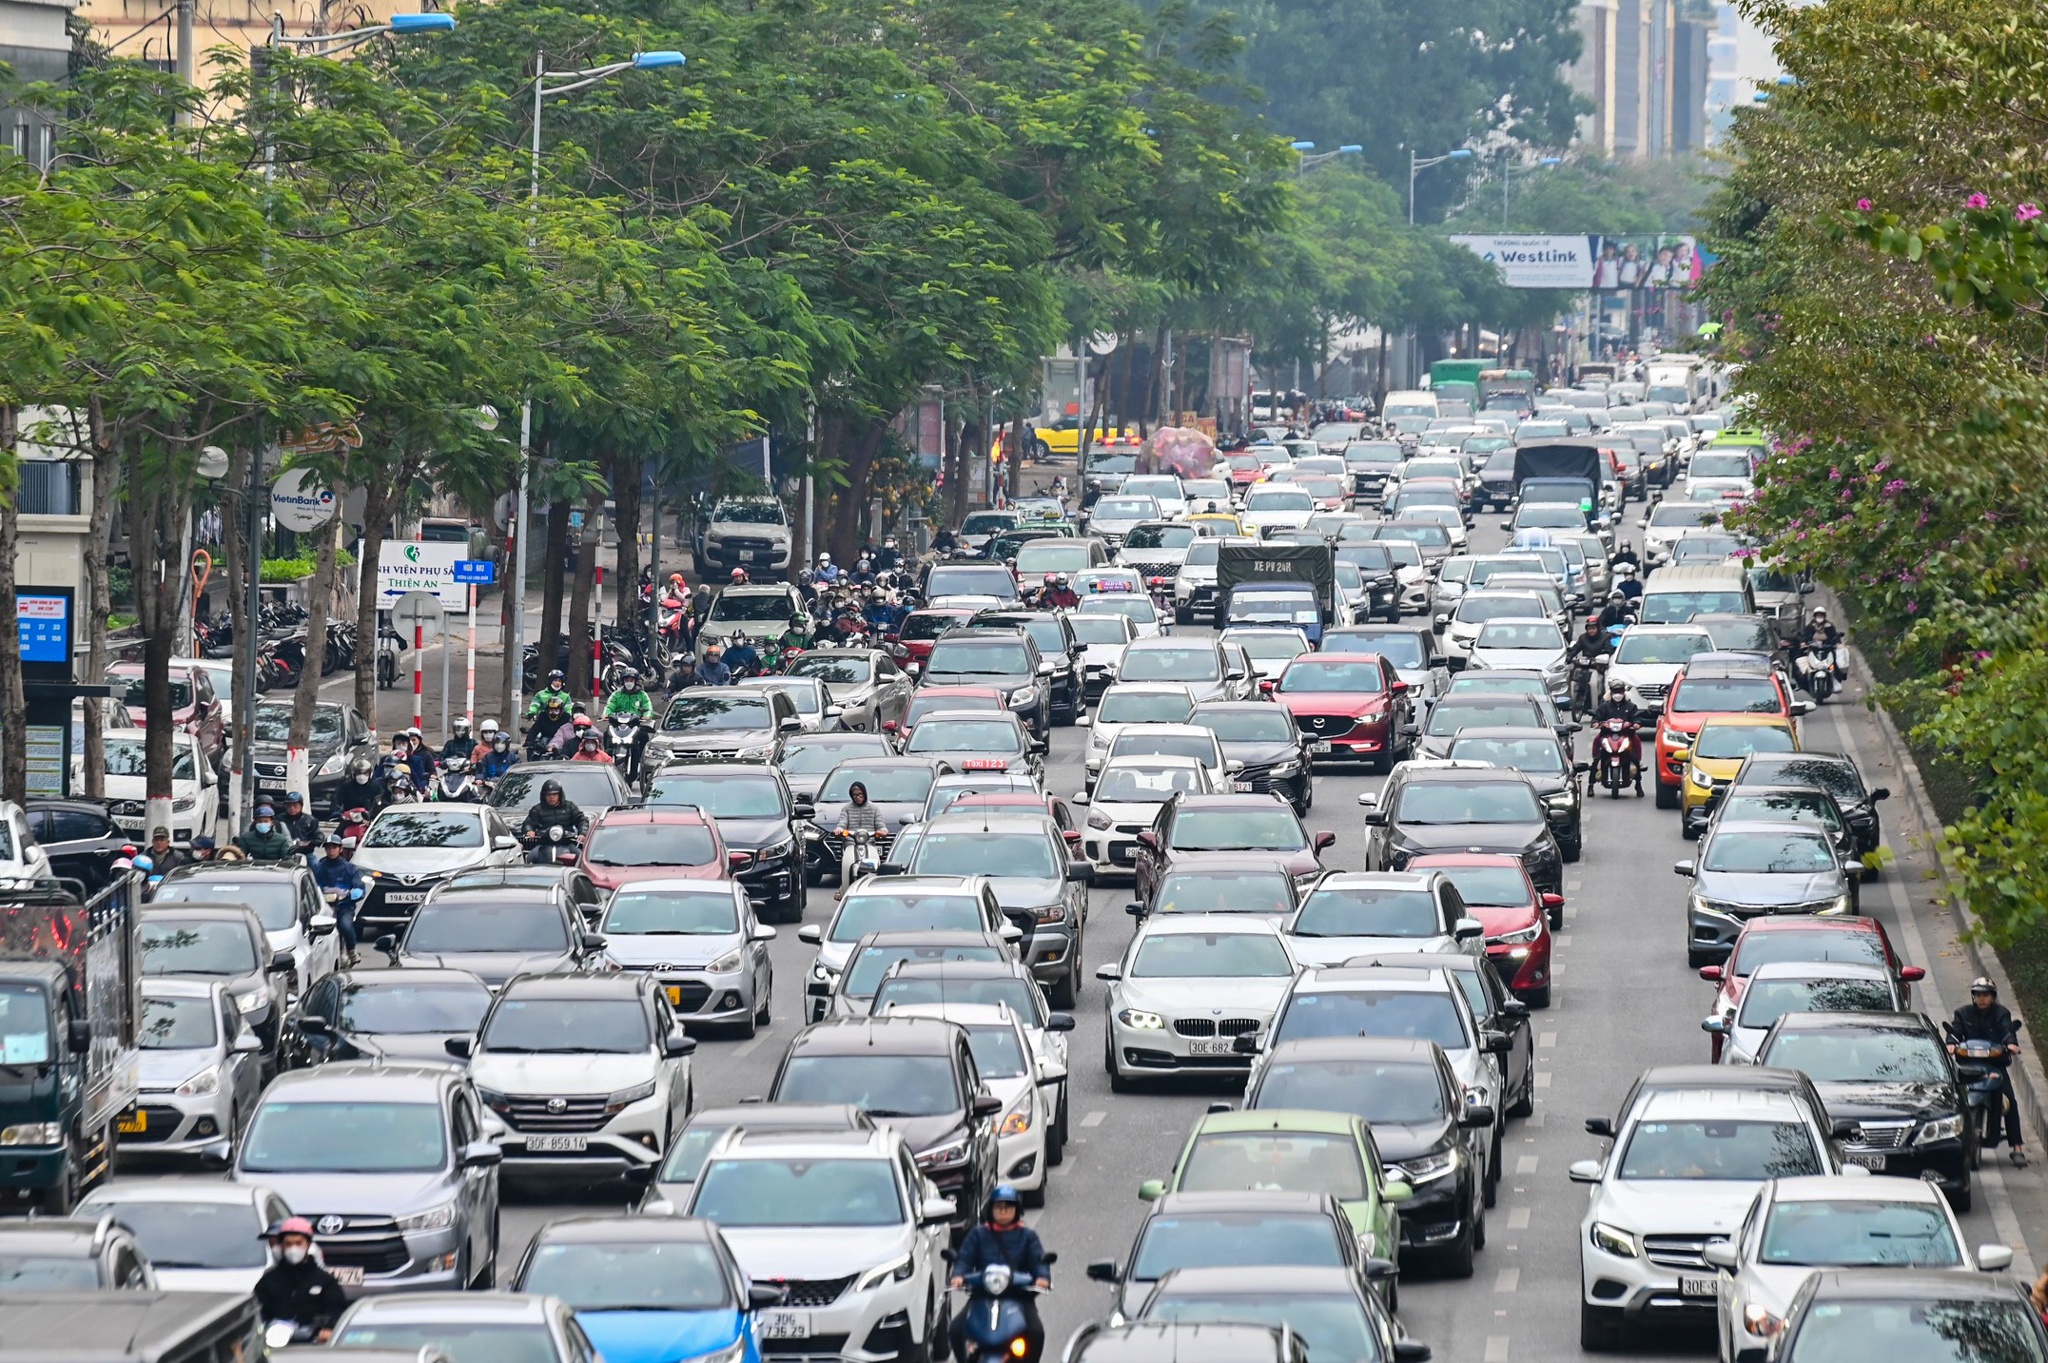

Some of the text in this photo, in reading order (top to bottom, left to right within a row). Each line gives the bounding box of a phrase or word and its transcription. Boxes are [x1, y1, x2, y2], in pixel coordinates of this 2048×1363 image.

[1501, 249, 1578, 263] Westlink
[273, 493, 321, 505] VietinBank
[393, 564, 419, 575] VIỆN
[420, 567, 441, 575] PHỤ
[1254, 561, 1292, 572] XE PV 24H
[388, 578, 438, 589] THIỆN AN
[966, 760, 1005, 768] Taxi 123
